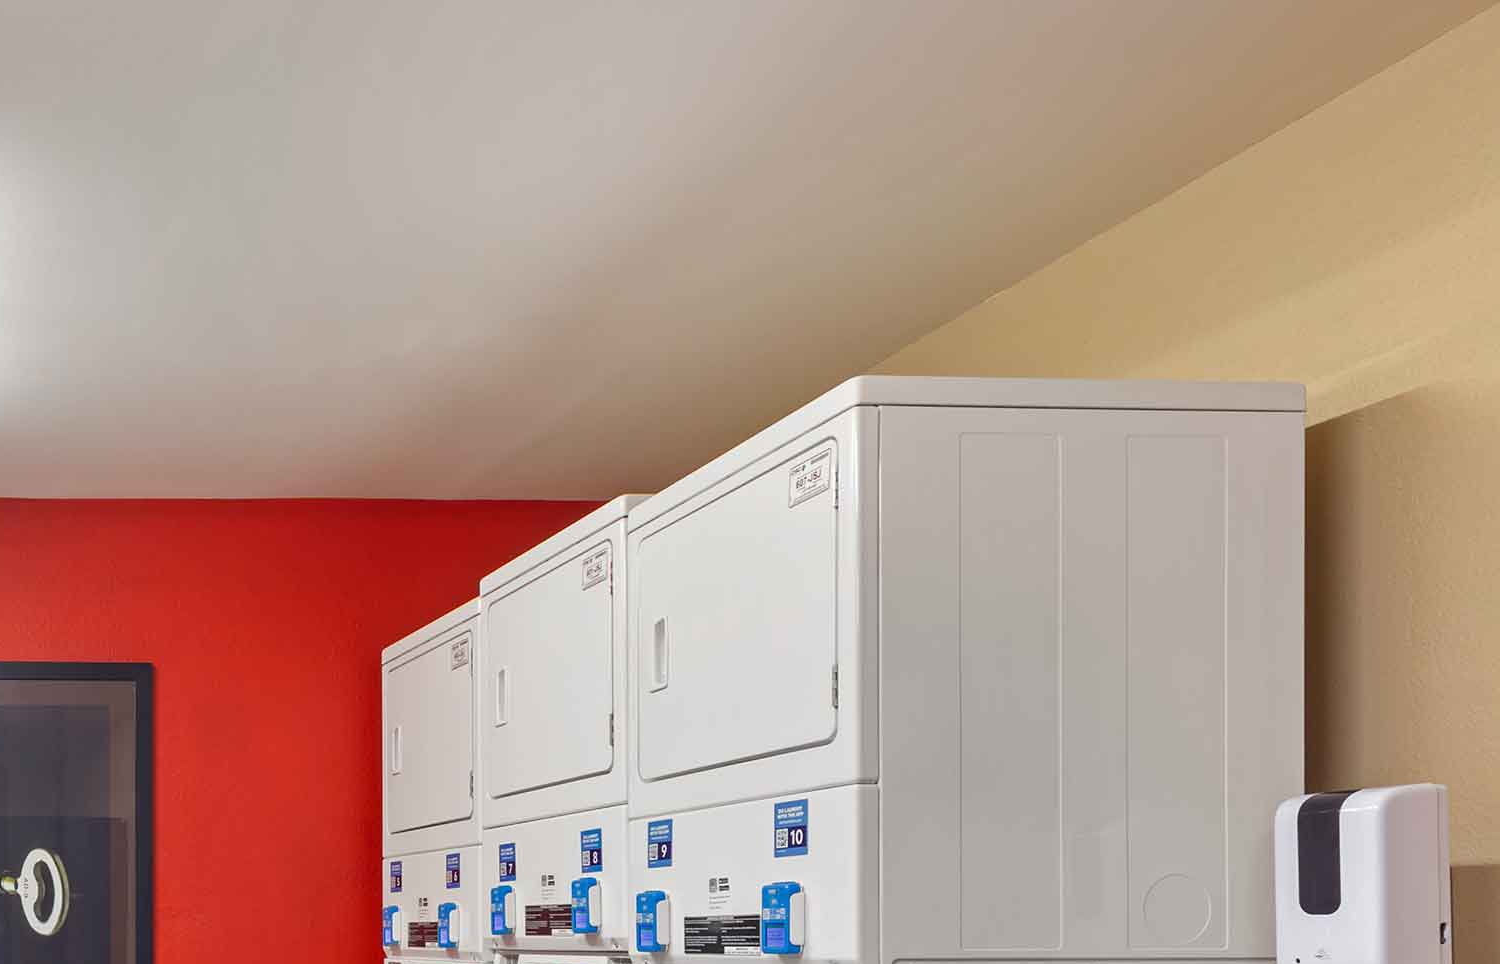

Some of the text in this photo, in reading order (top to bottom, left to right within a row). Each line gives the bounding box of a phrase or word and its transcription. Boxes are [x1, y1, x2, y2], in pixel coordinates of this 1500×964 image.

[790, 829, 803, 845] 10
[592, 851, 598, 864] 8
[661, 844, 667, 858] 9
[508, 863, 513, 874] 7
